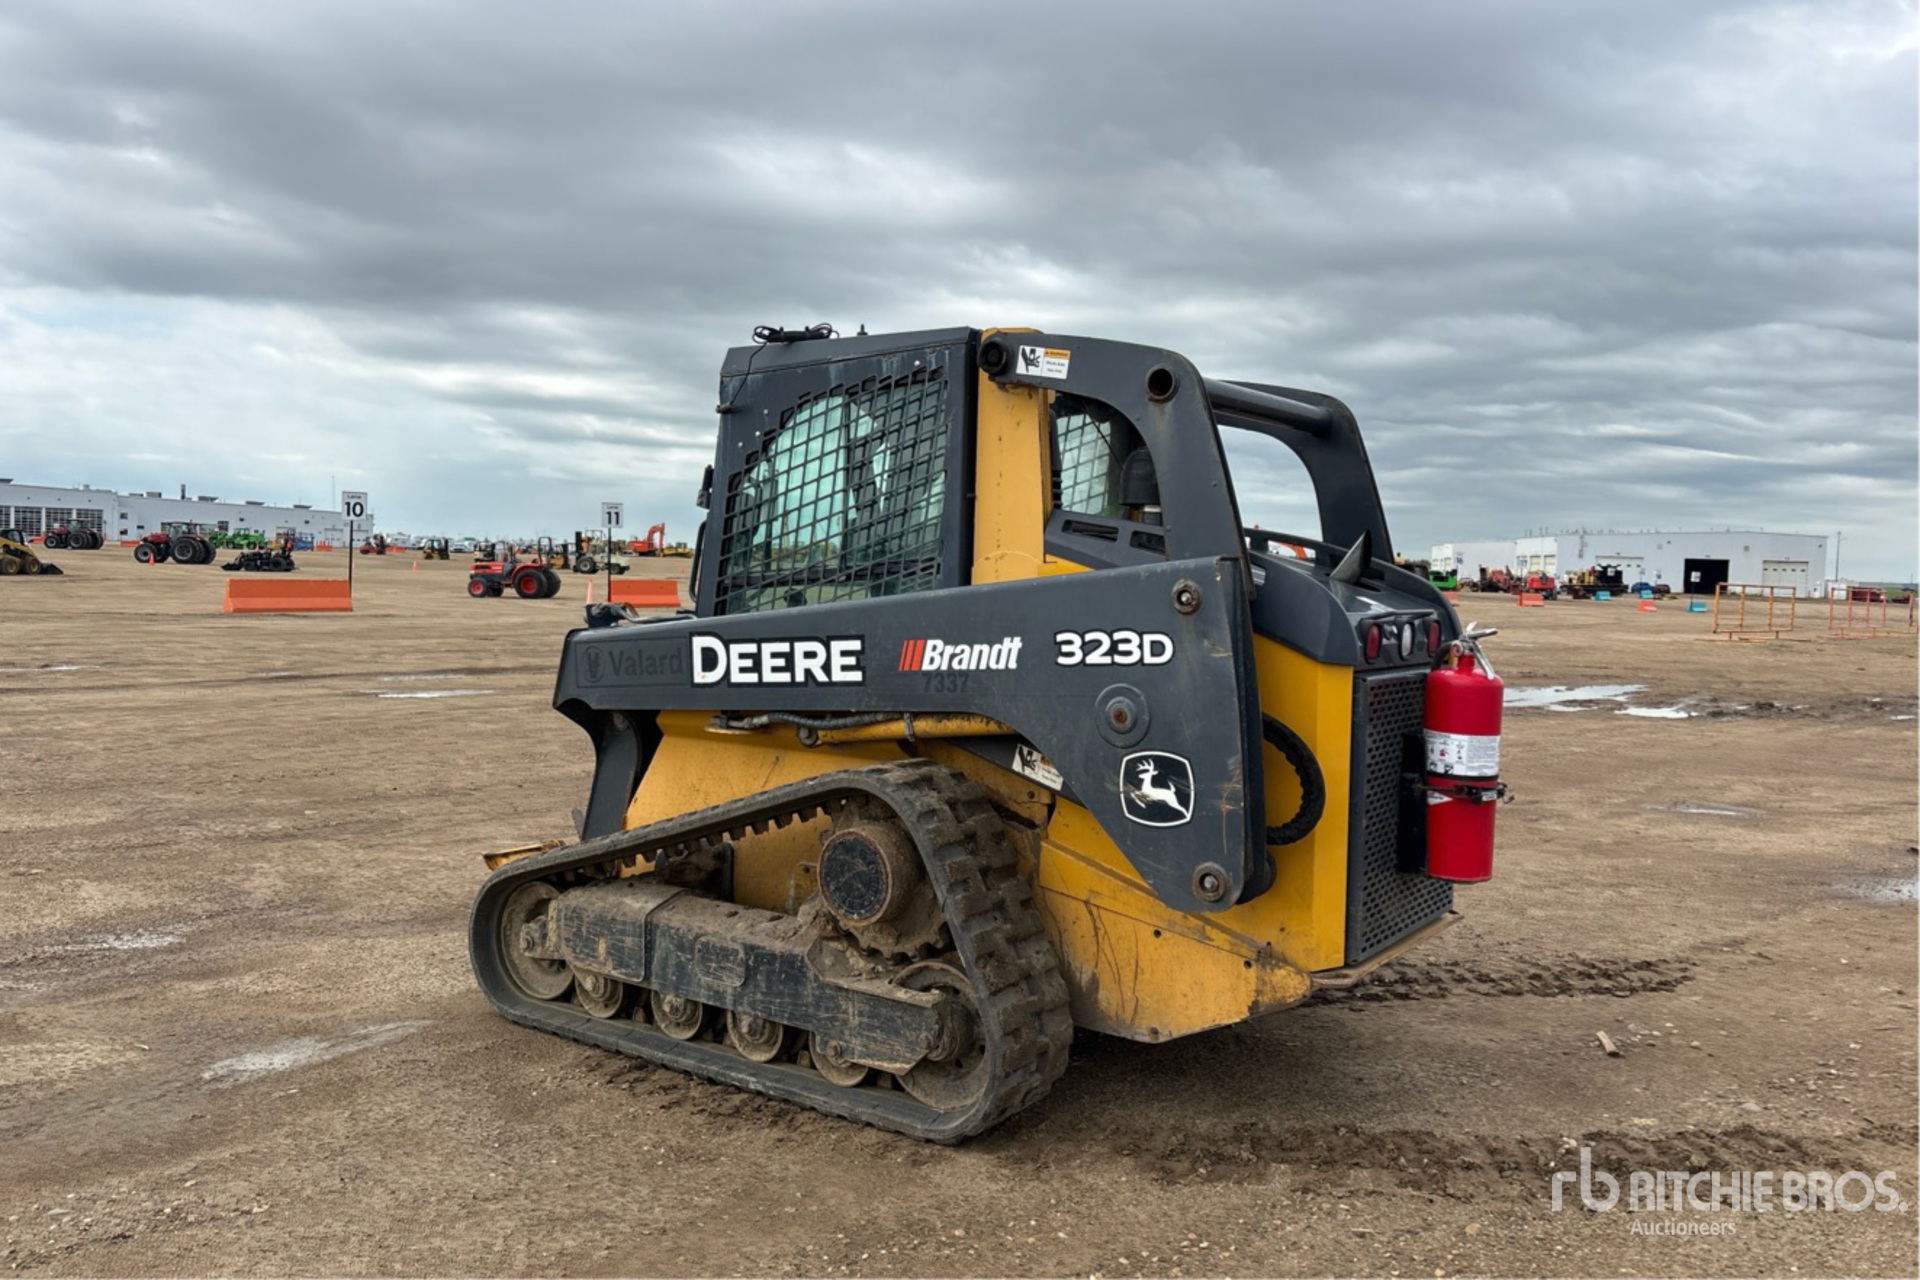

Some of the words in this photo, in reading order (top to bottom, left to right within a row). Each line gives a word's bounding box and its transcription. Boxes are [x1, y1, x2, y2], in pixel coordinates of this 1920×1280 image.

[345, 501, 364, 518] 10
[605, 511, 620, 526] 11
[608, 647, 683, 677] Valard
[691, 635, 865, 685] DEERE
[921, 636, 1022, 671] Brandt
[1055, 630, 1174, 667] 323D
[921, 672, 970, 694] 7337
